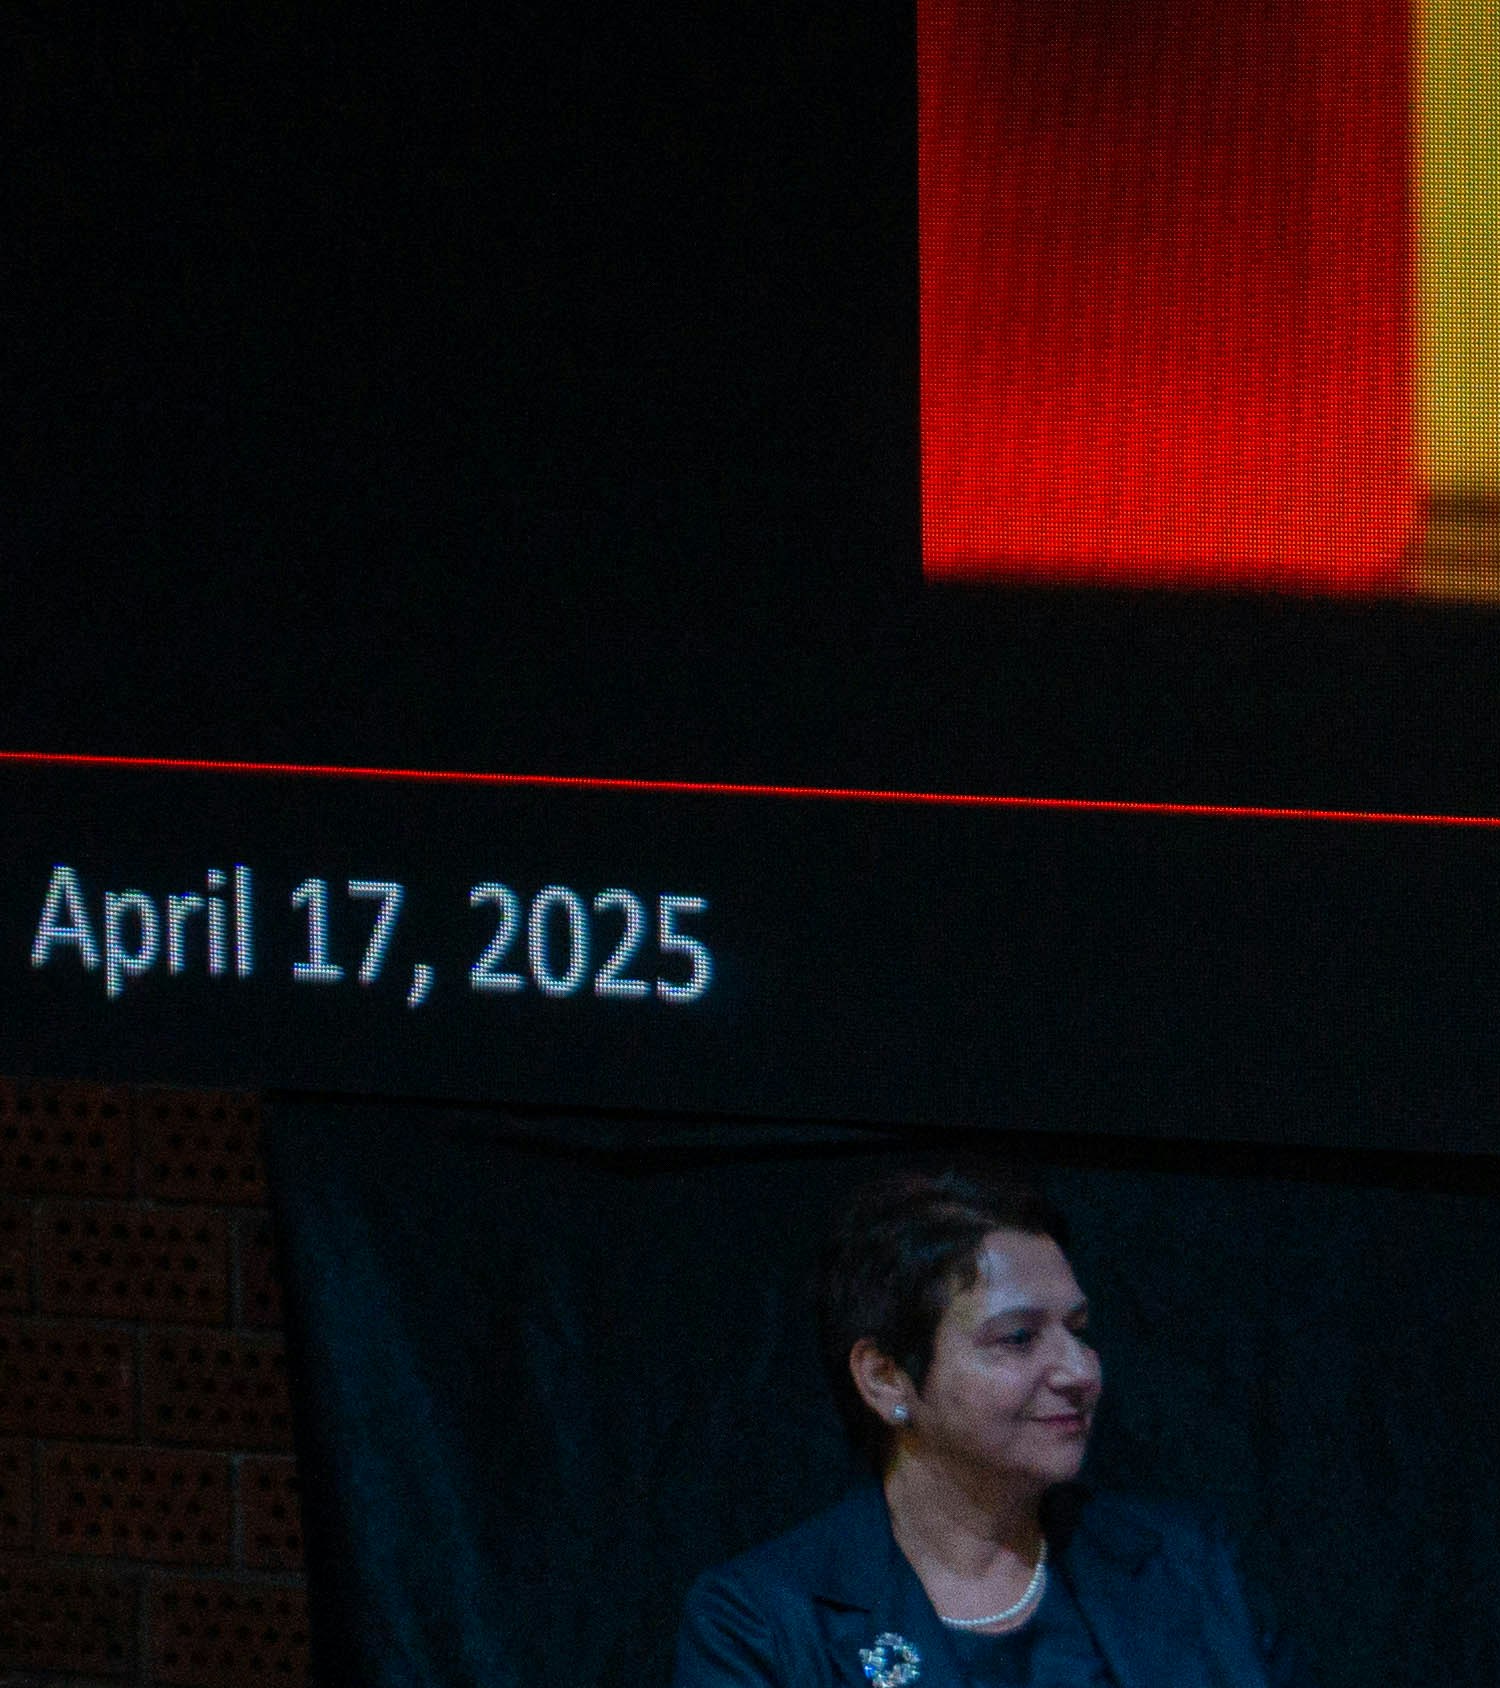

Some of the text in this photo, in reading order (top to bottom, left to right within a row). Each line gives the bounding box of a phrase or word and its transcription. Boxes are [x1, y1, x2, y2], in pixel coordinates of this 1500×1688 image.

[31, 863, 714, 1007] April 17, 2025
